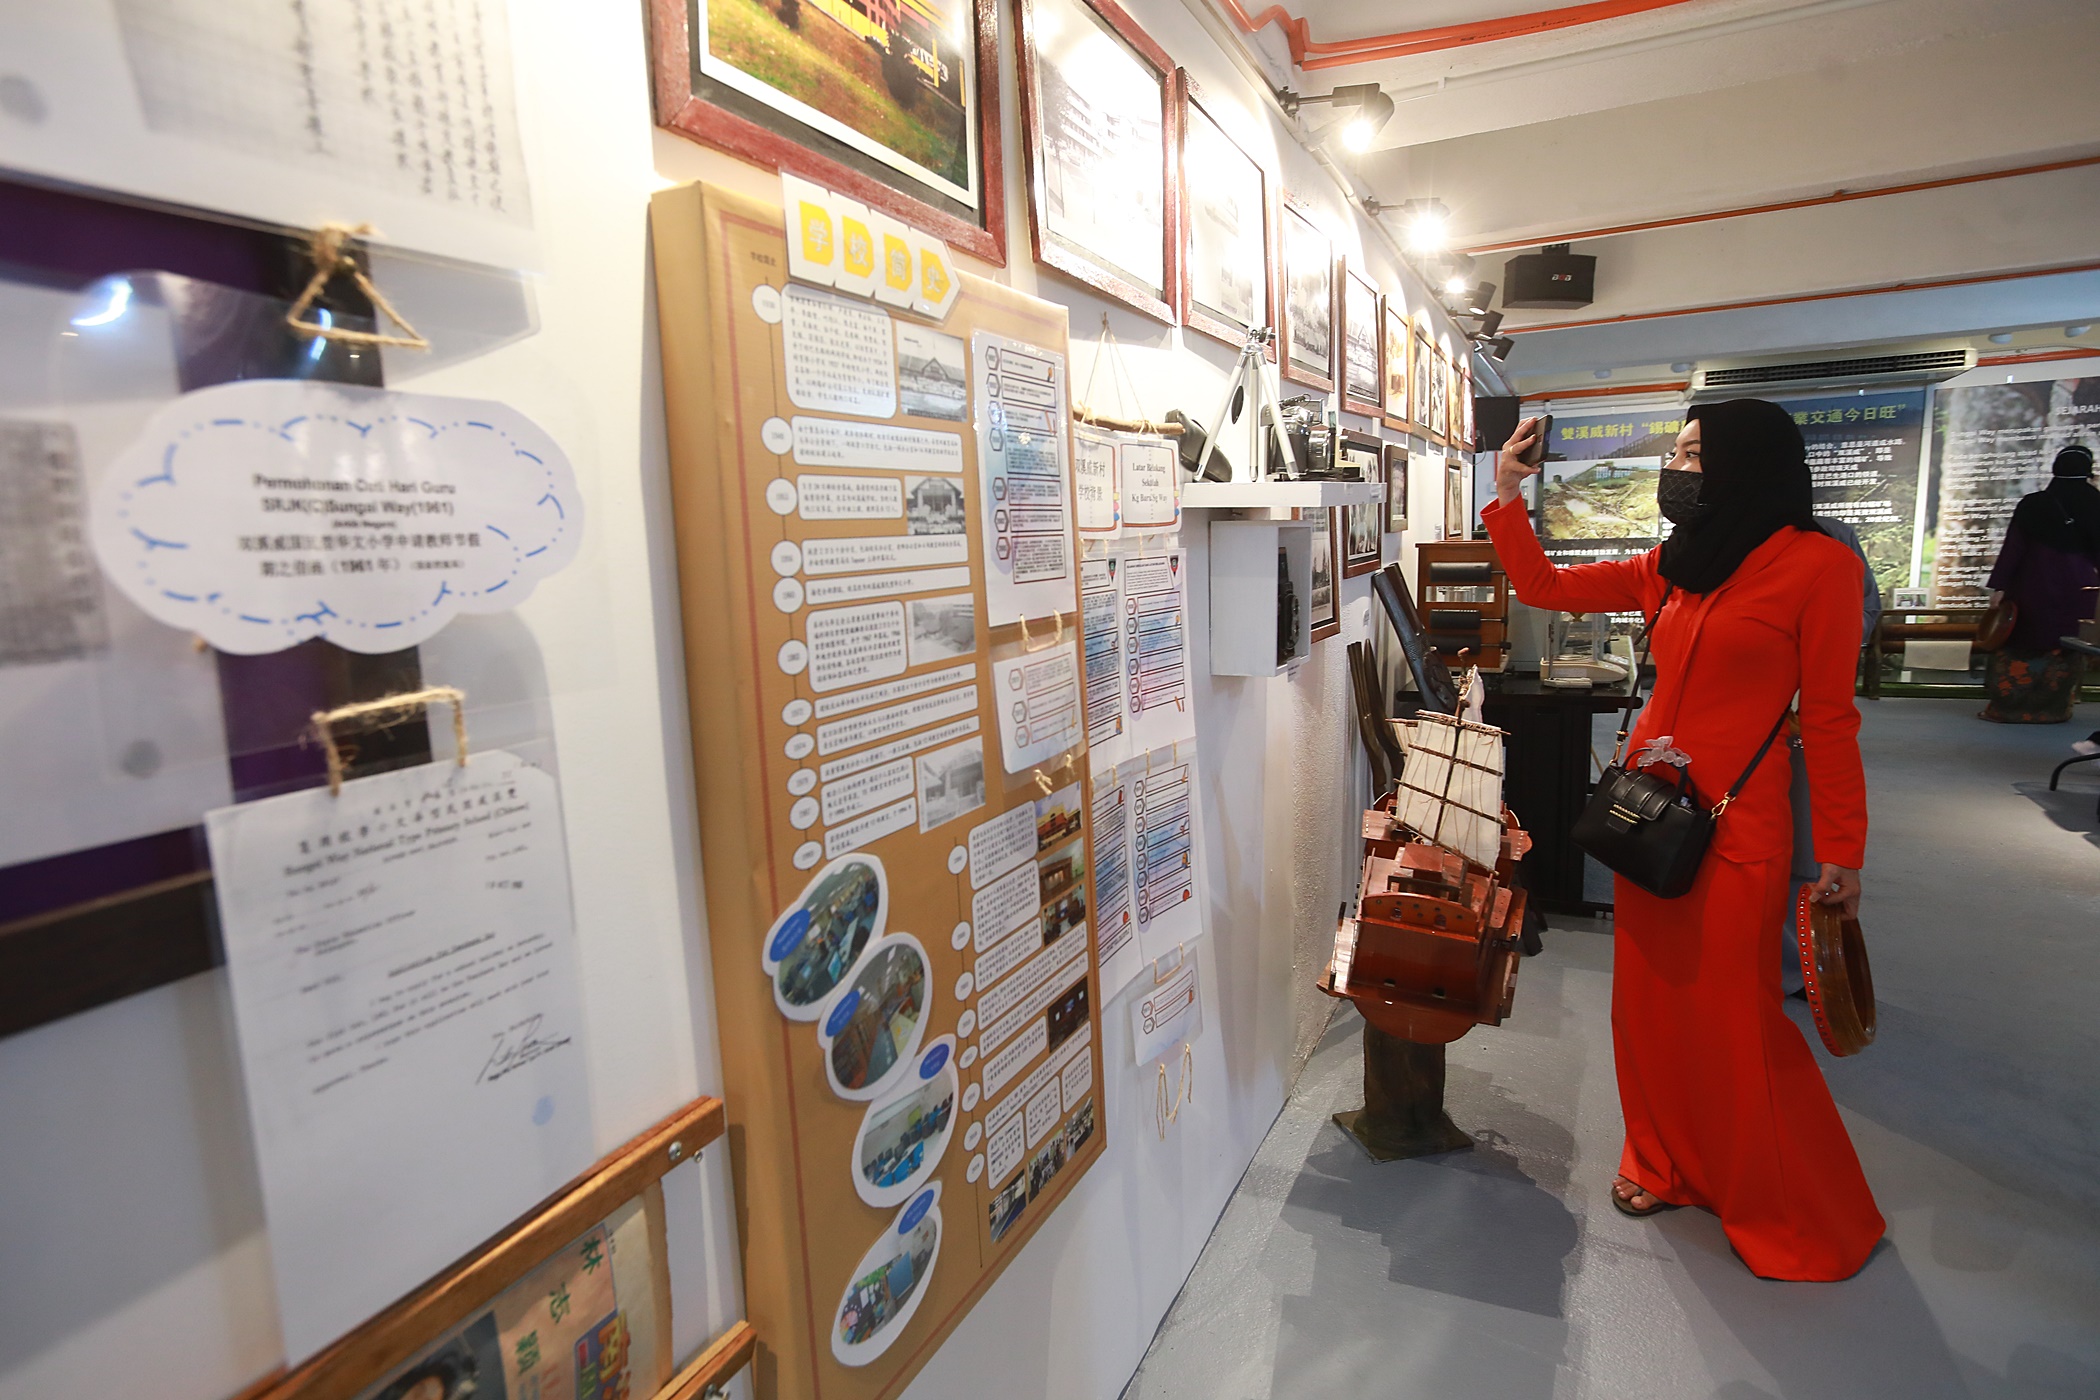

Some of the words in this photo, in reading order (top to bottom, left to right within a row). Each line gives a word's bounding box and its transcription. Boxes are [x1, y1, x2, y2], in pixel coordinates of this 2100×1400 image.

[809, 218, 941, 293] 学校简史
[1792, 404, 1906, 425] 業交通今日旺”
[1560, 423, 1634, 440] 雙溪威新村
[388, 481, 418, 493] Hari
[421, 481, 456, 495] Guru
